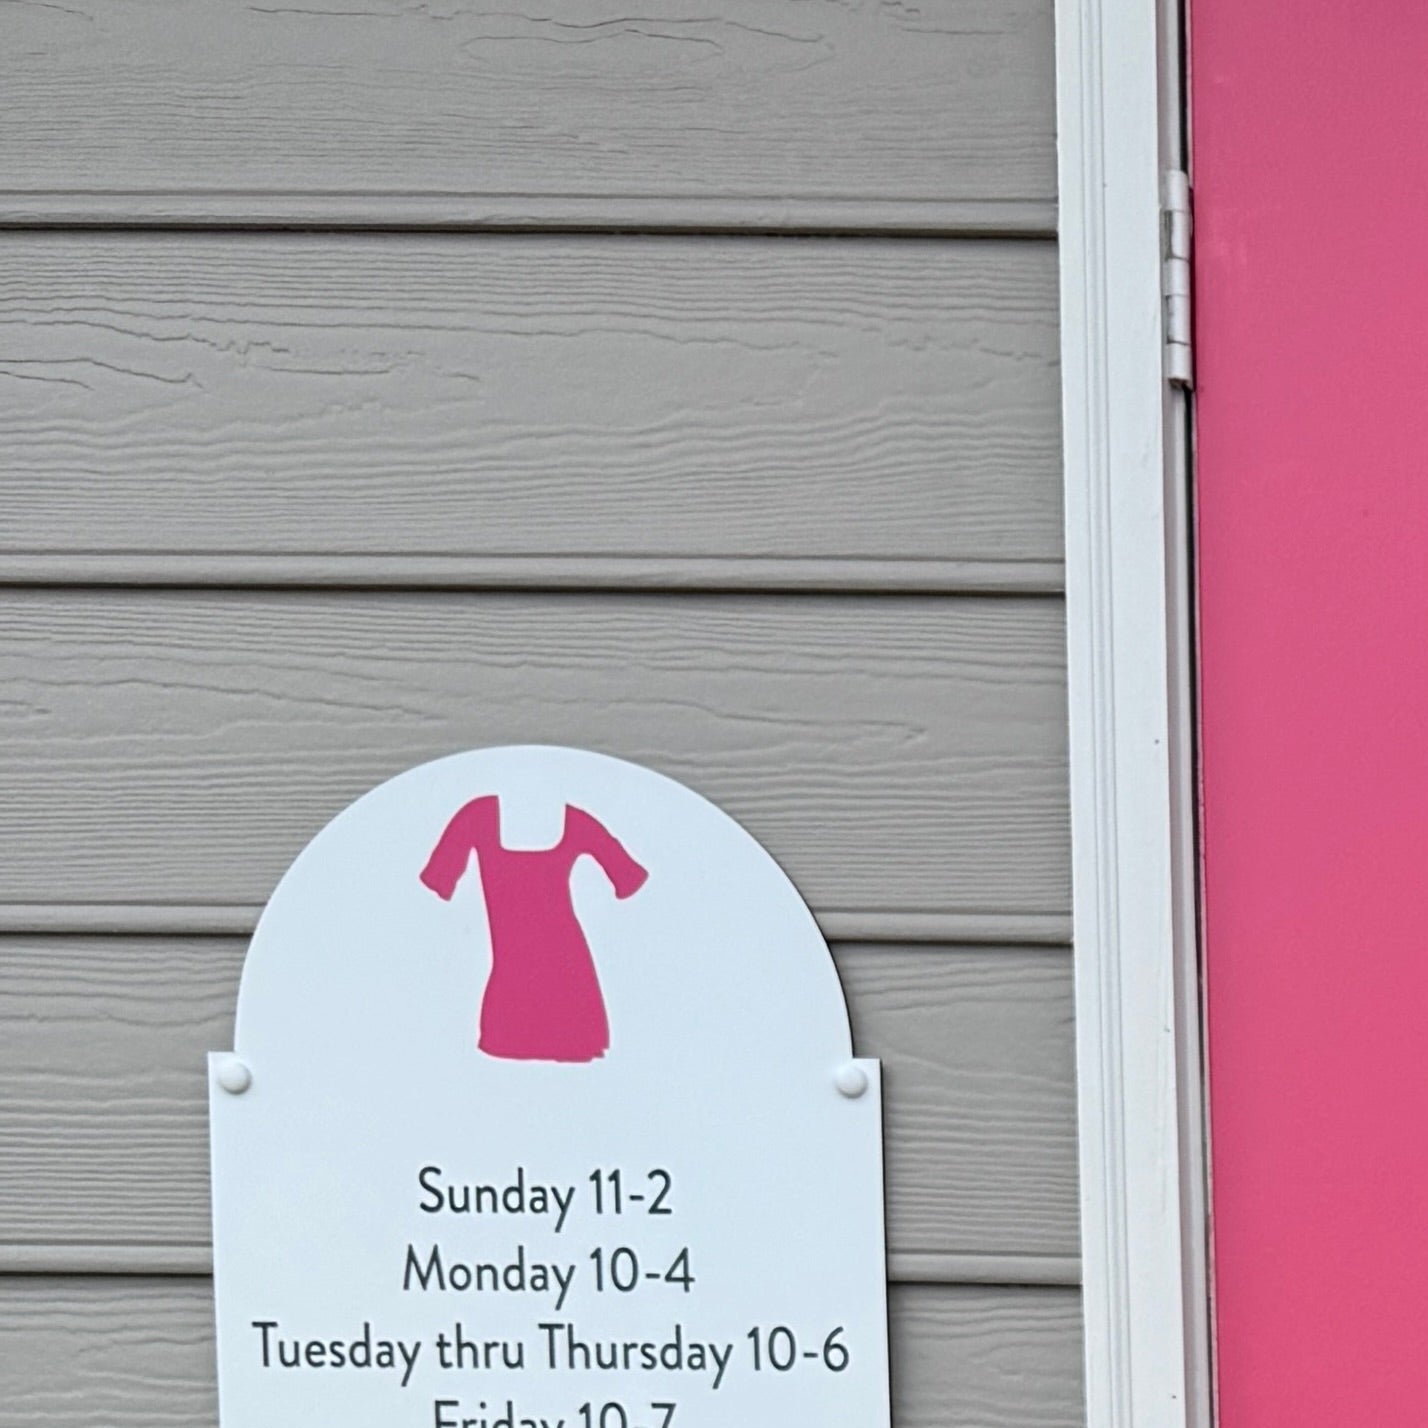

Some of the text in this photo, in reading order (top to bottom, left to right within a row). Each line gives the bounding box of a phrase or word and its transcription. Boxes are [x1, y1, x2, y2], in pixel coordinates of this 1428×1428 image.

[417, 1165, 674, 1235] Sunday 11-2
[402, 1243, 697, 1312] Monday 10-4
[250, 1320, 850, 1391] Tuesday thru Thursday 10-6
